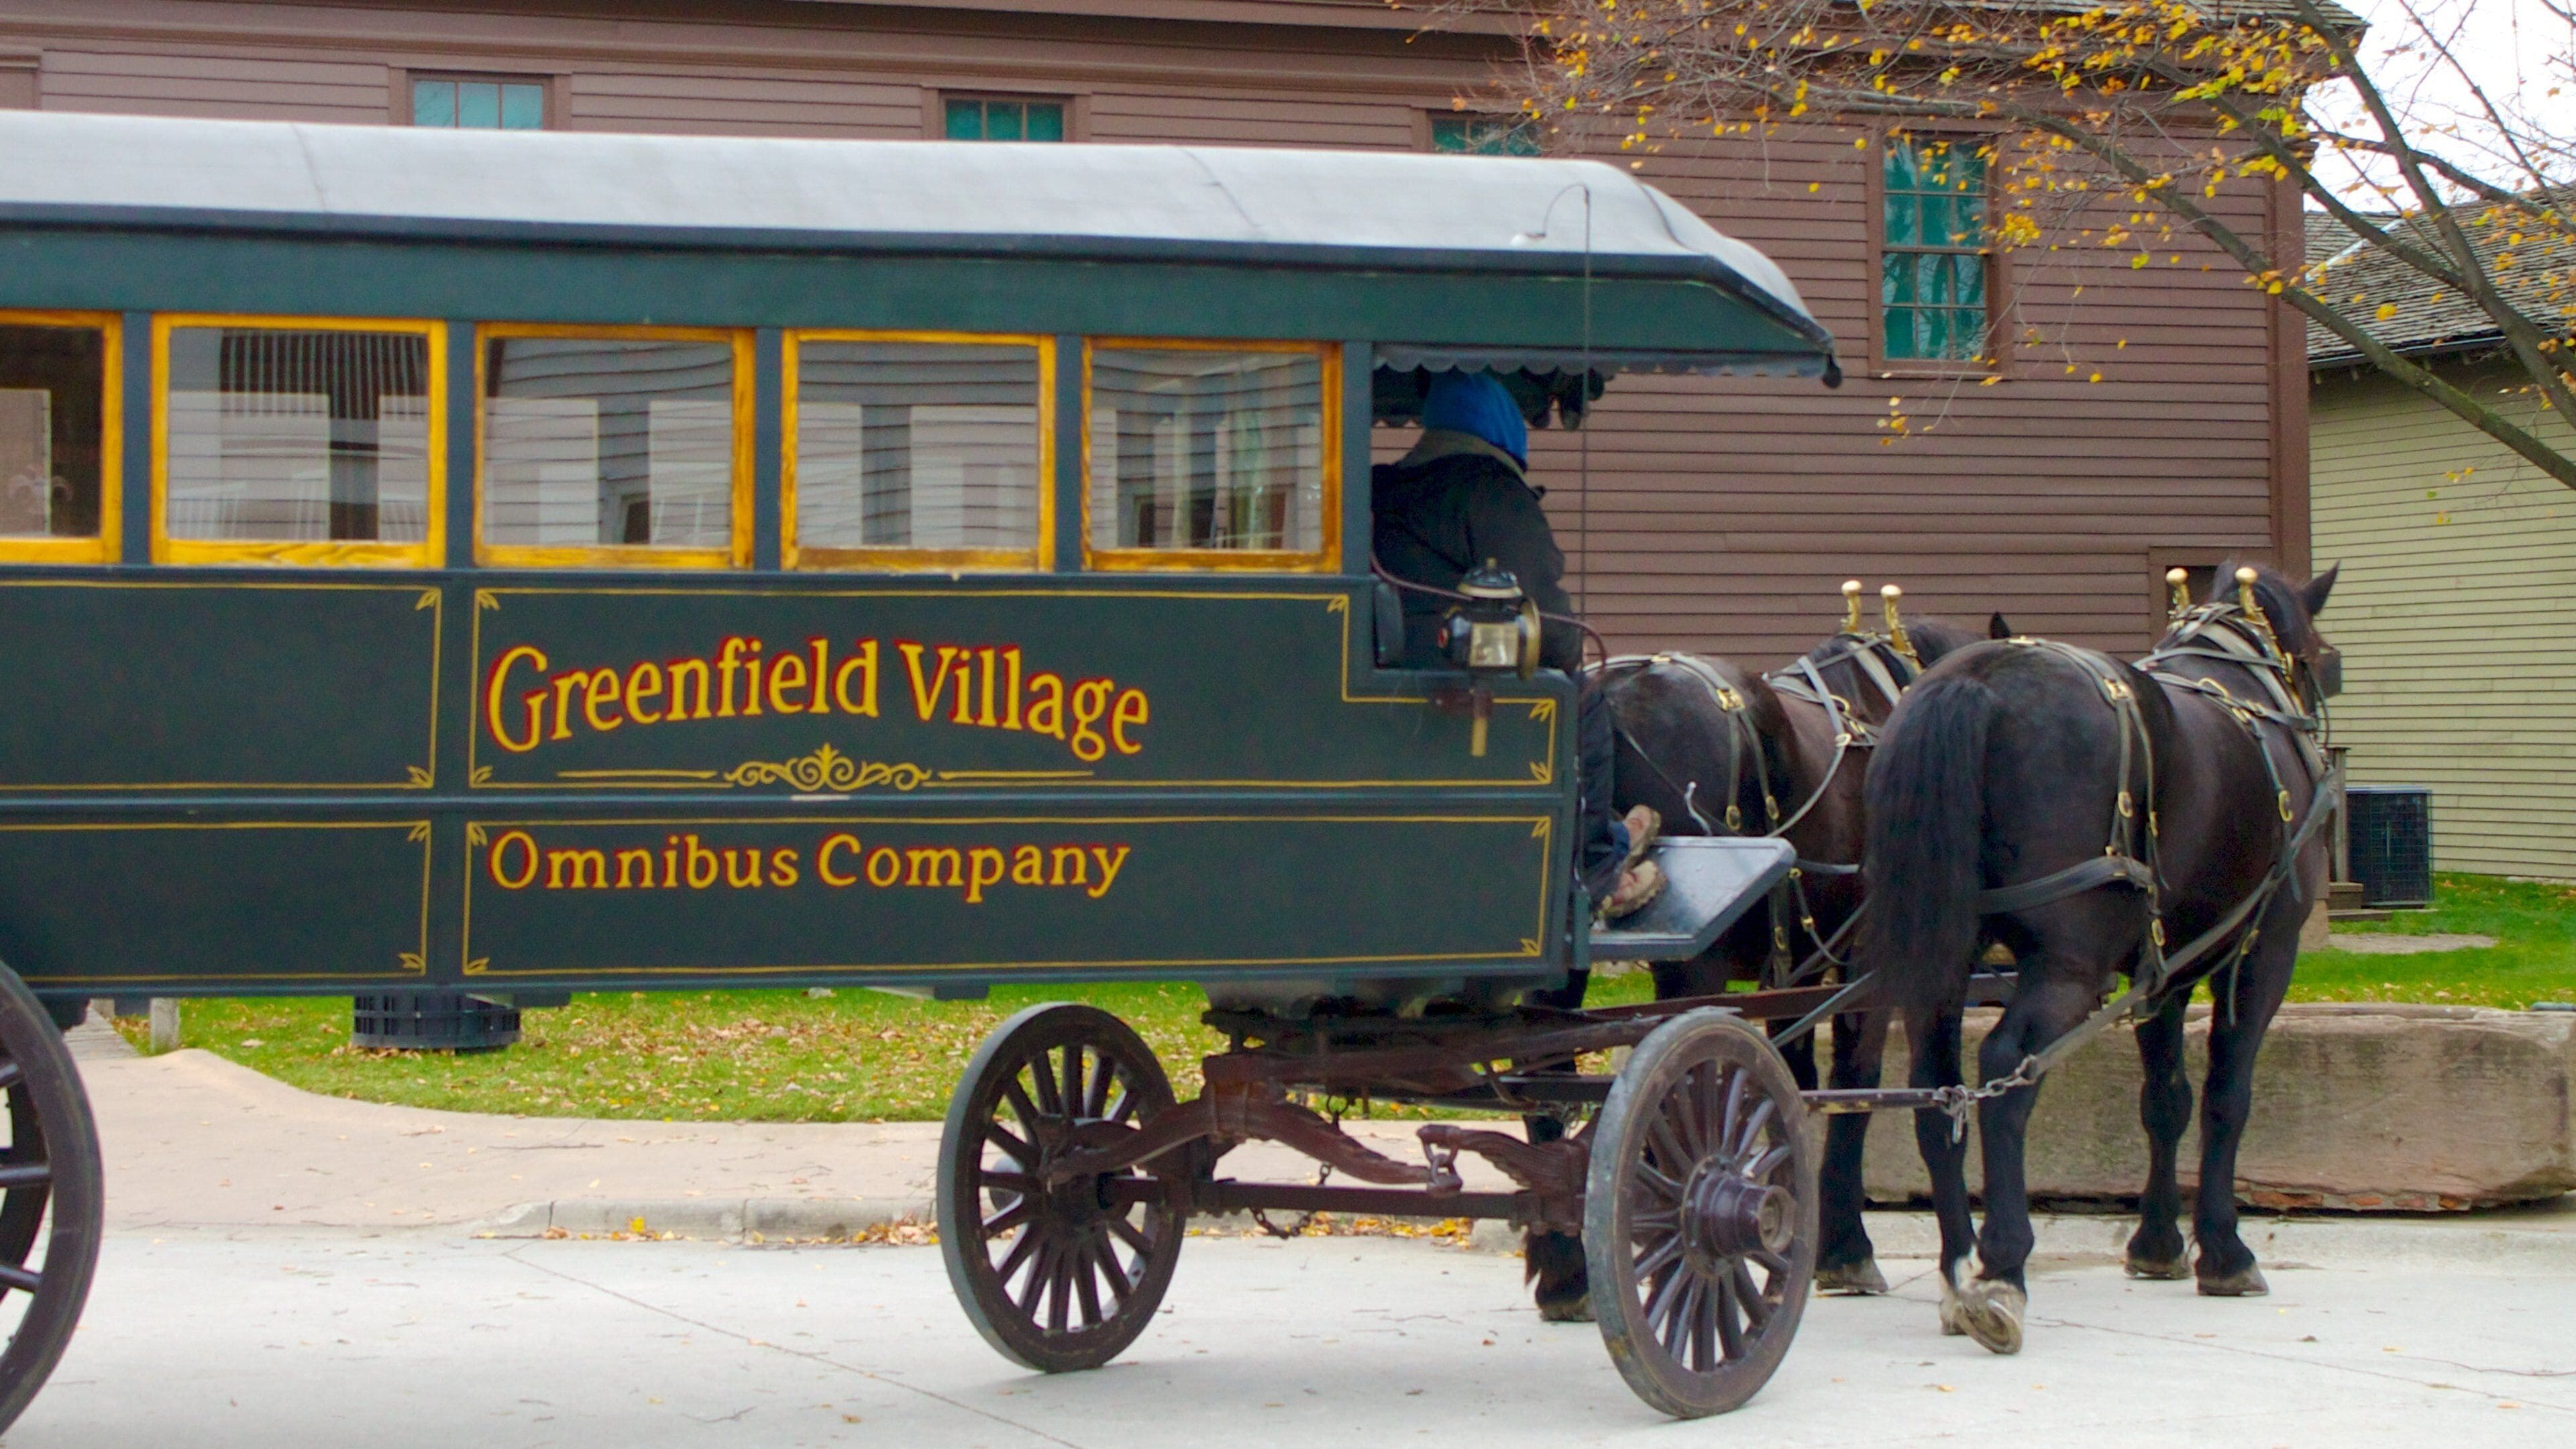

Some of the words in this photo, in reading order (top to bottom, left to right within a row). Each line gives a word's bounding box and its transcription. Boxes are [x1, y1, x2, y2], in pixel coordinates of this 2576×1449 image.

[484, 635, 879, 753] Greenfield
[894, 639, 1149, 761] Village
[488, 829, 799, 890] Omnibus
[816, 833, 1130, 903] Company
